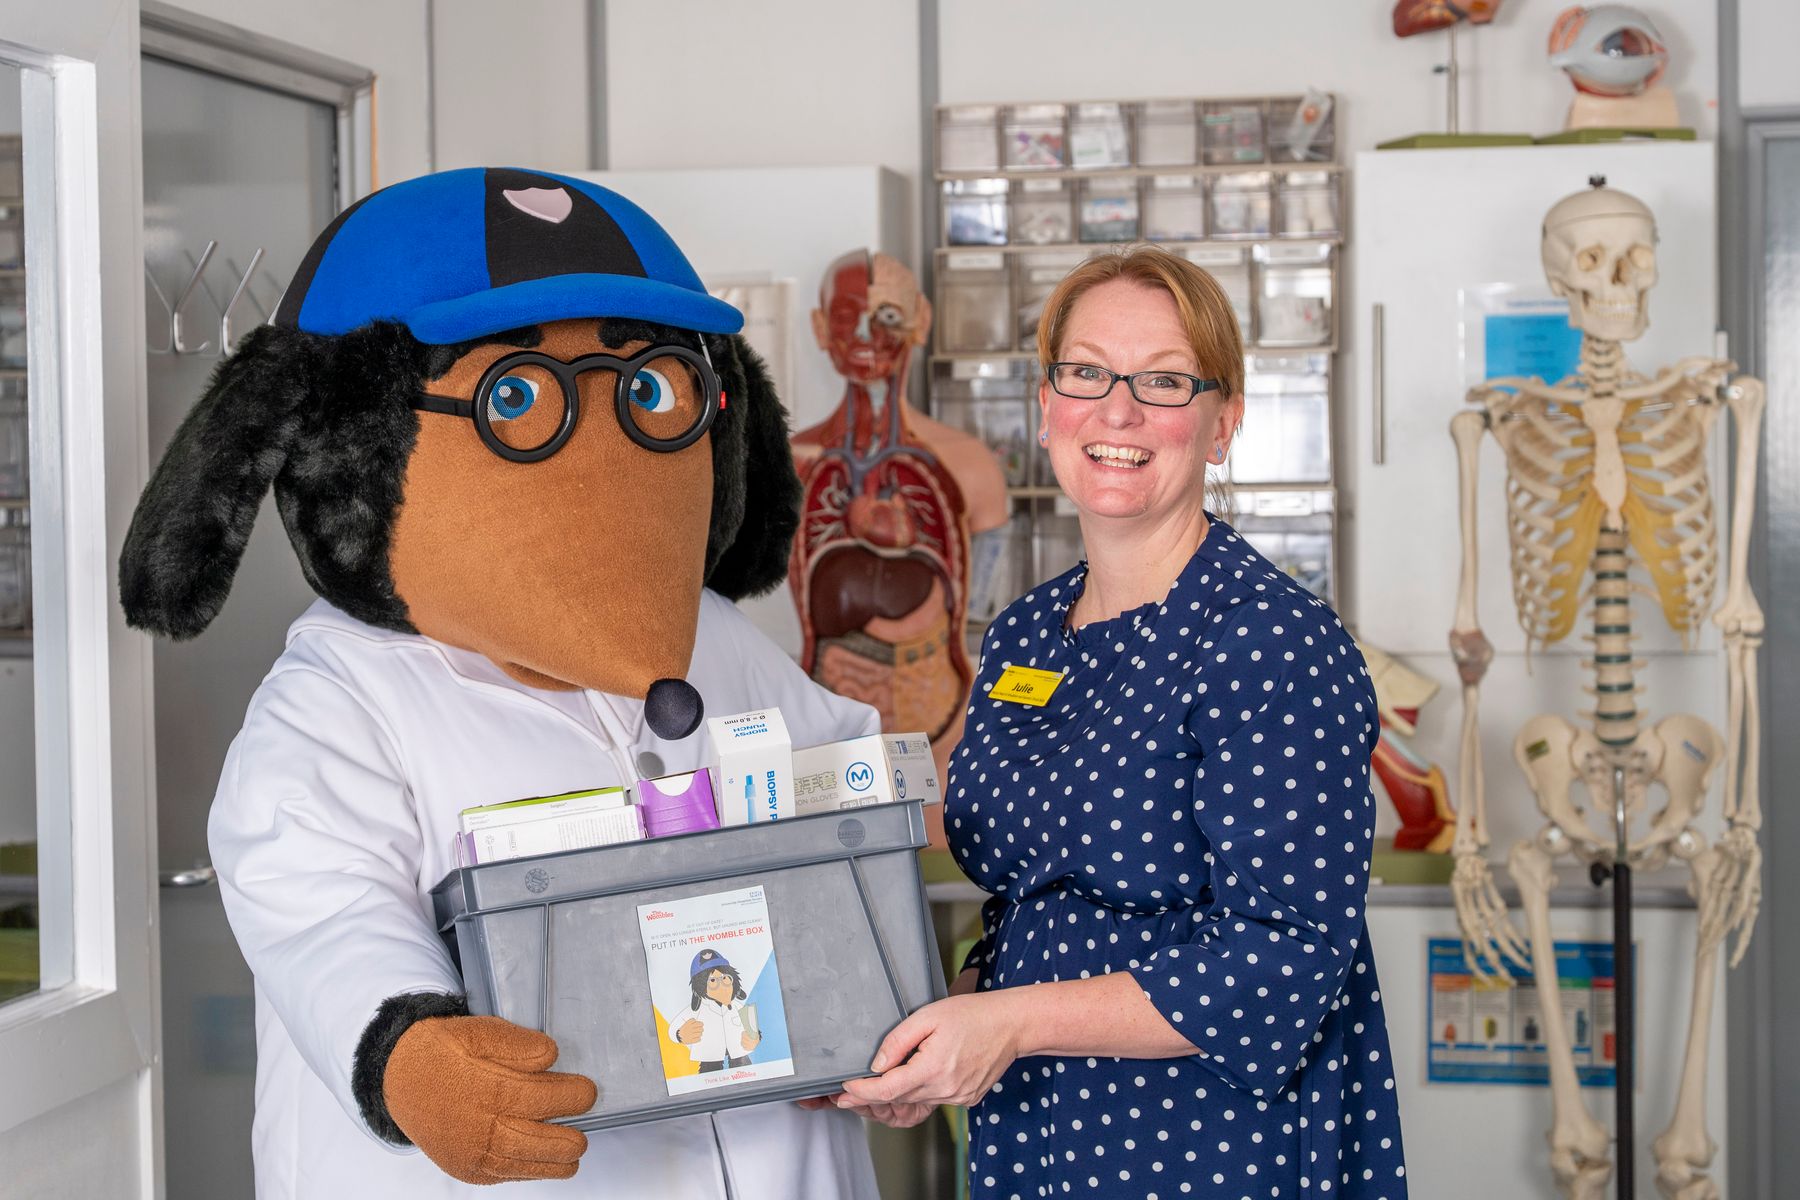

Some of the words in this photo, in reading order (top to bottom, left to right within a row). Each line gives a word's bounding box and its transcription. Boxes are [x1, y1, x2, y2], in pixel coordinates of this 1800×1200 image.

[1011, 682, 1034, 694] Julie
[733, 723, 765, 732] PUNCH
[735, 727, 768, 737] BIOPSY
[767, 770, 777, 810] BIOPSY
[810, 792, 838, 803] GLOVES
[769, 813, 778, 822] P
[651, 941, 668, 950] PUT
[670, 940, 677, 948] IT
[679, 938, 688, 946] IN
[689, 935, 705, 944] THE
[707, 929, 744, 942] WOMBLE
[746, 926, 764, 935] BOX
